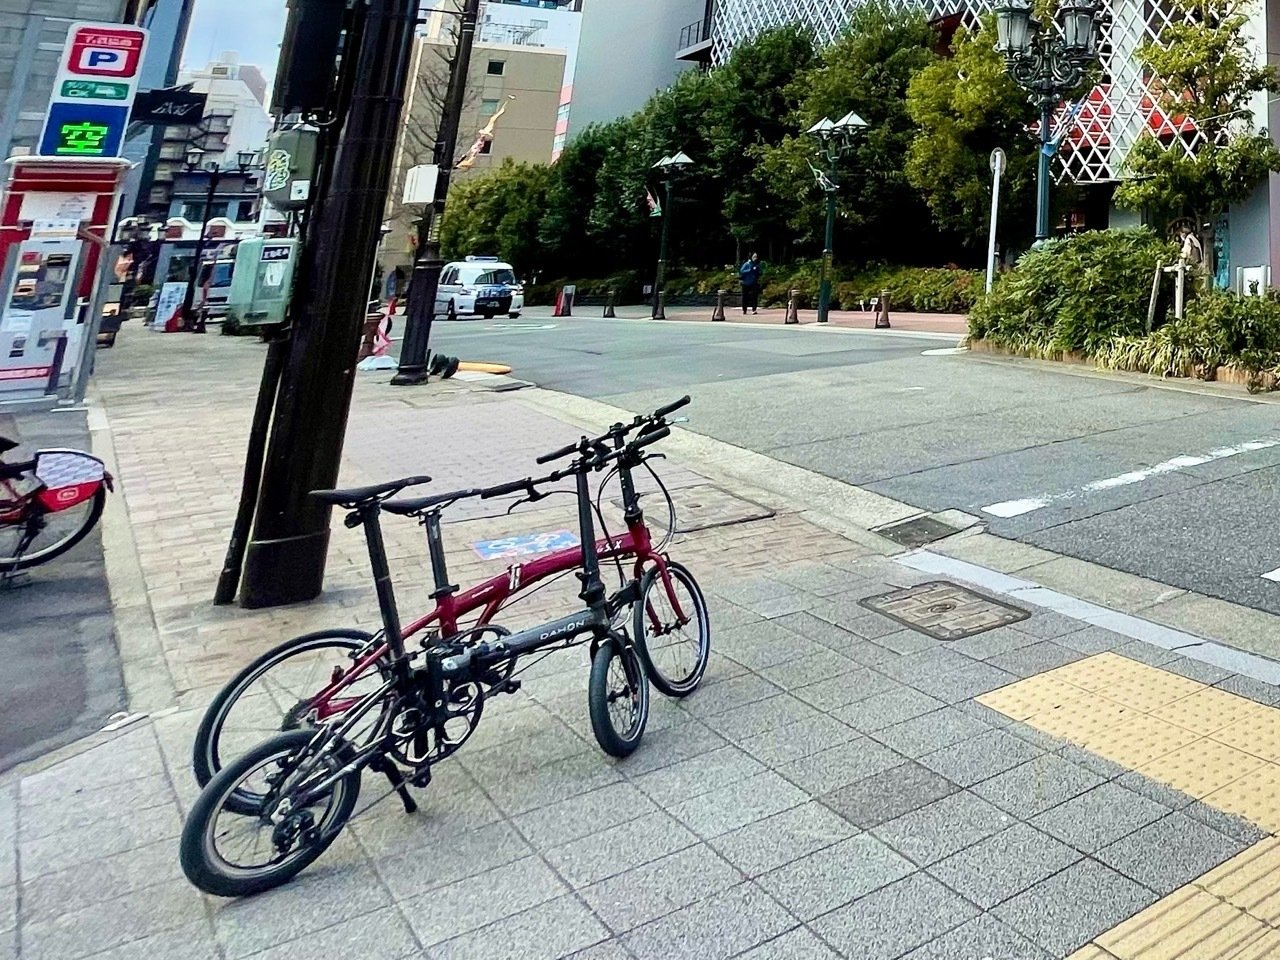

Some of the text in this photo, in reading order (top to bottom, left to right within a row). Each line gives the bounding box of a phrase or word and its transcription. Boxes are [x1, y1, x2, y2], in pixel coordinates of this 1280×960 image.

[88, 51, 118, 67] P
[56, 122, 109, 154] 空
[539, 619, 586, 641] DAHON
